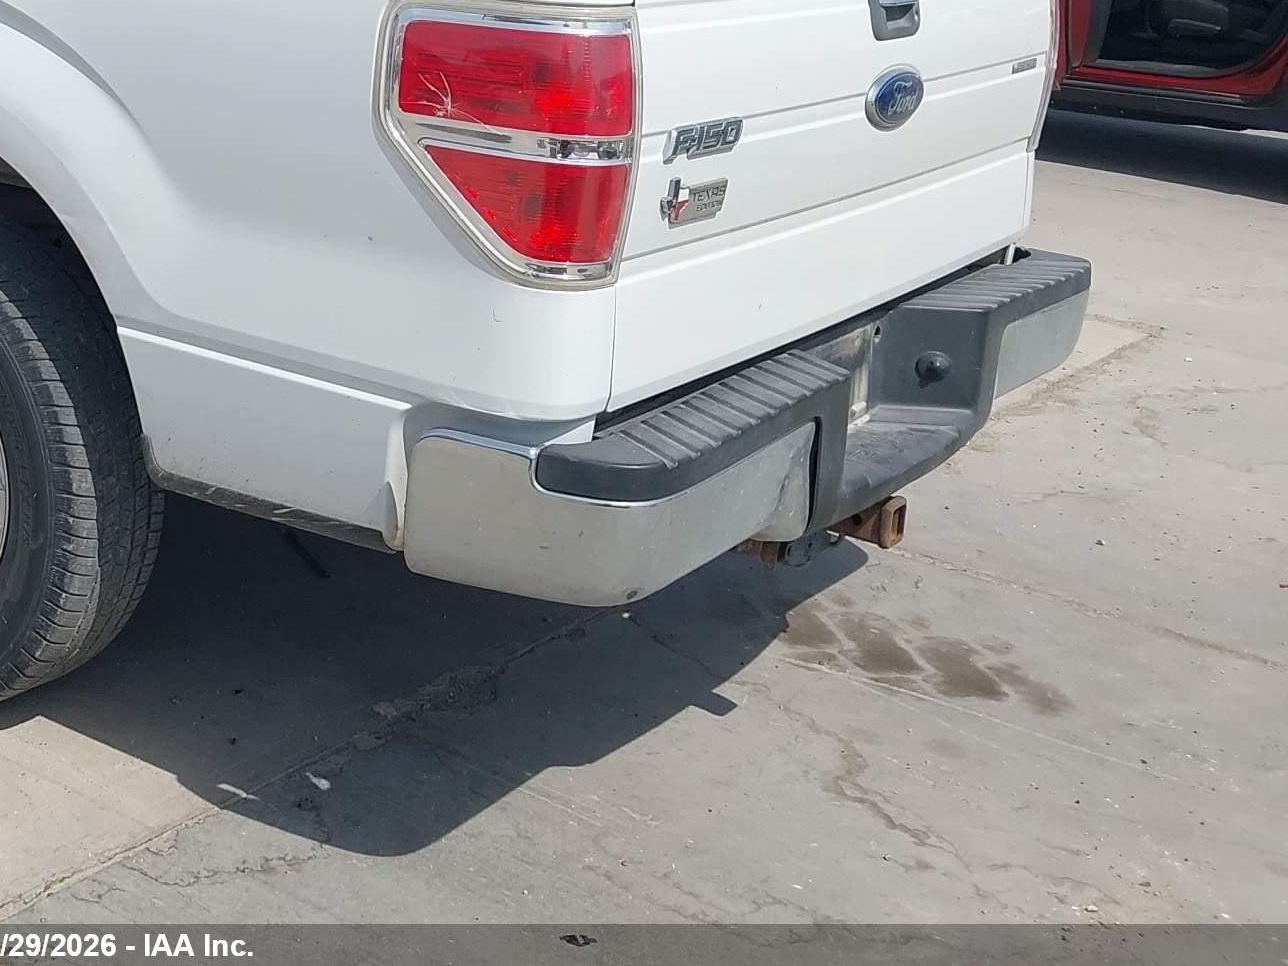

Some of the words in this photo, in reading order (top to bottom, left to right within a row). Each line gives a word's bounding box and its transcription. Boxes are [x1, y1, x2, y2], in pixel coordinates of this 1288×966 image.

[887, 81, 921, 116] Ford
[665, 117, 743, 161] F-150
[692, 185, 727, 203] TEXAS
